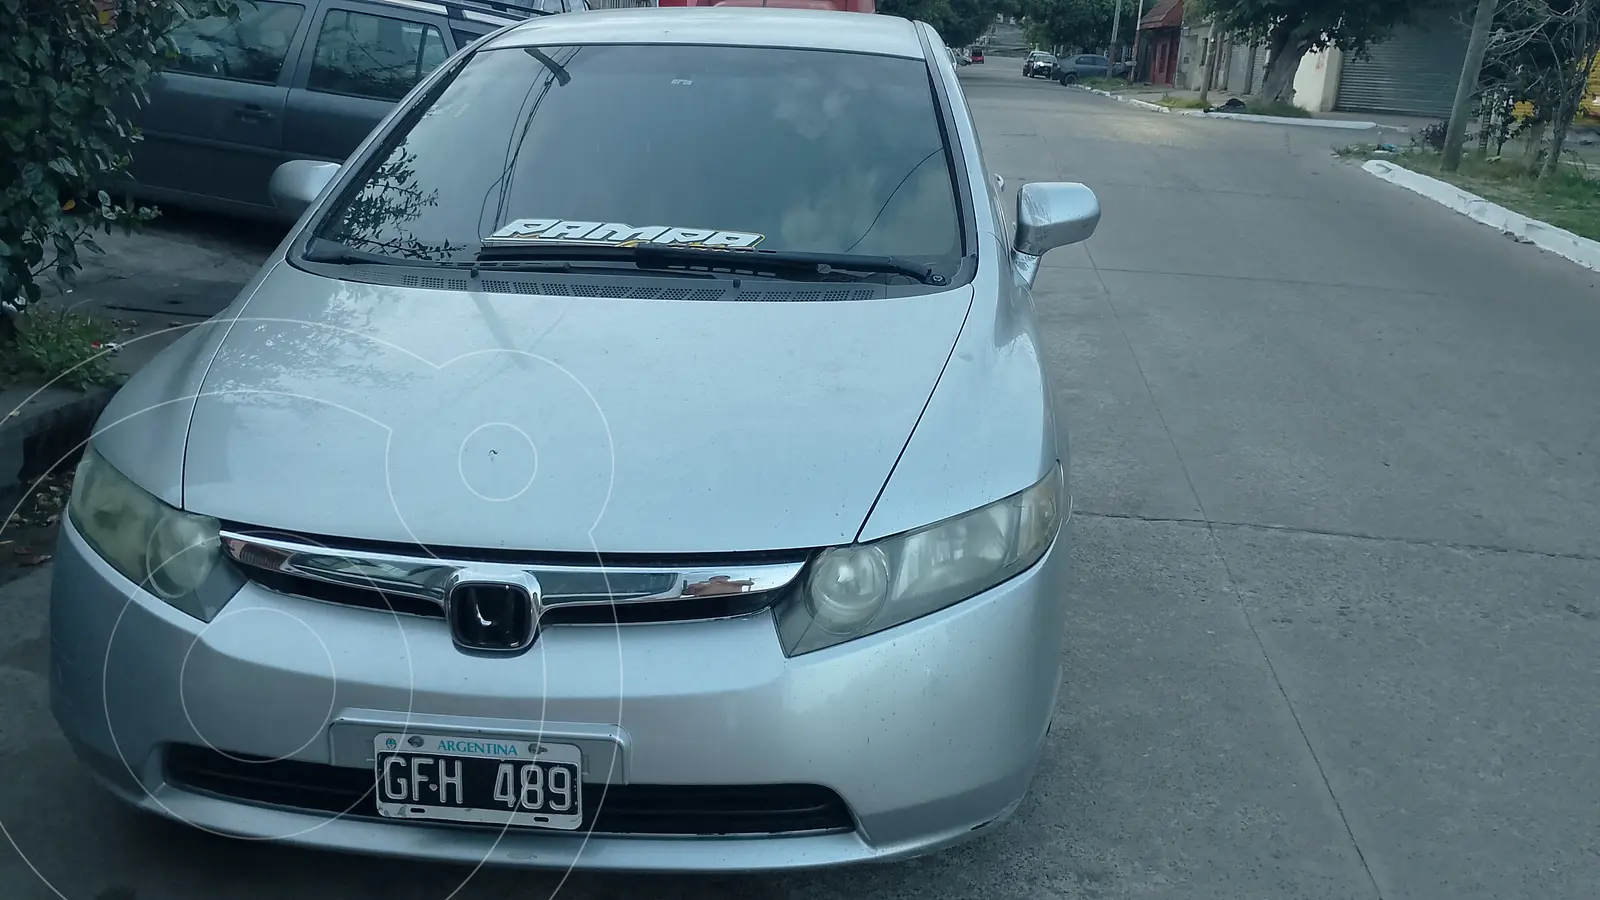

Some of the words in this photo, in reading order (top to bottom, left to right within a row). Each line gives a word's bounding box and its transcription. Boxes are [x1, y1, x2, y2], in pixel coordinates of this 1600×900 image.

[491, 218, 763, 248] PAMPA
[437, 739, 518, 756] ARGENTINA
[384, 756, 464, 804] GFH
[494, 763, 572, 811] 489
